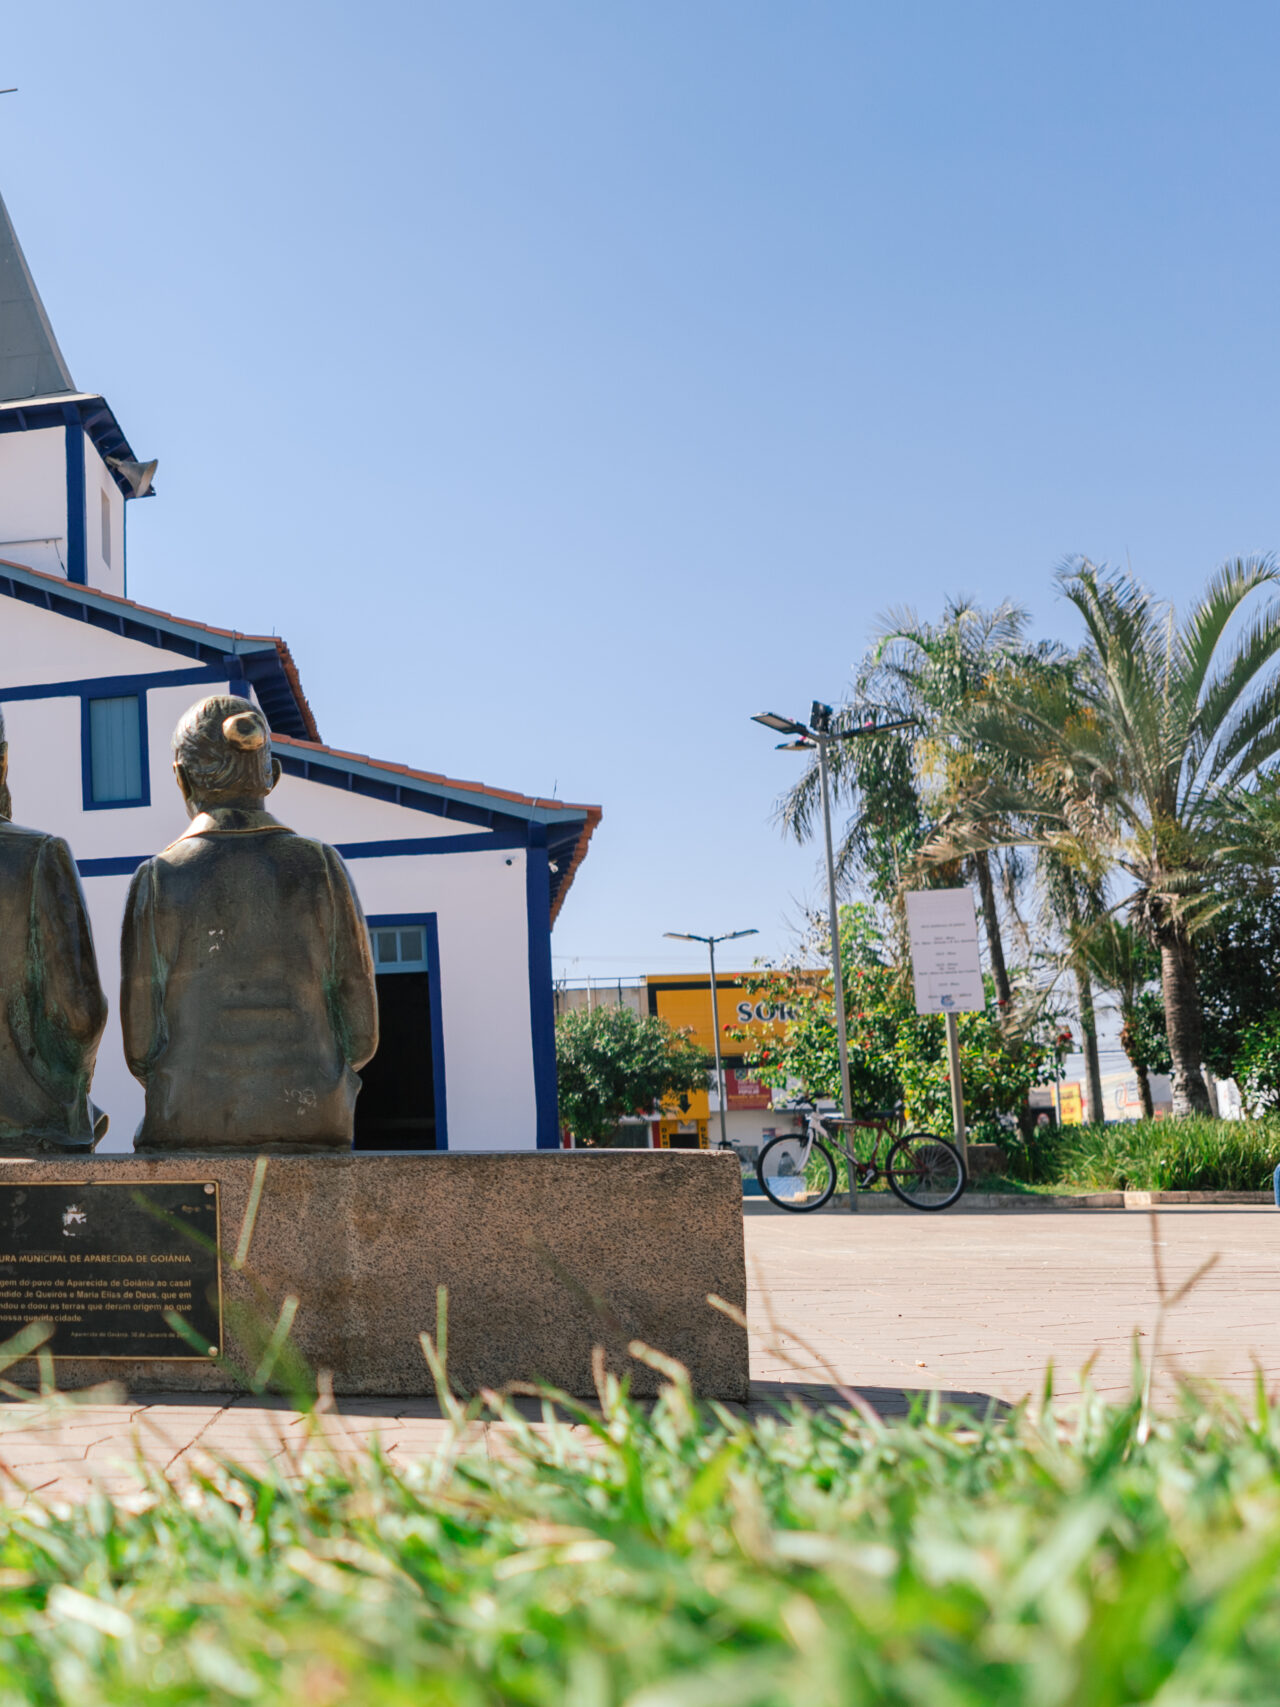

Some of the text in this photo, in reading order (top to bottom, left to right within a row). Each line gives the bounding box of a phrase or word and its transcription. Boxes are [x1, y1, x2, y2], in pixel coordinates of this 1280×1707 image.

[19, 1254, 67, 1263] MUNICIPAL
[70, 1254, 81, 1263] DE
[84, 1254, 133, 1263] APARECIDA
[136, 1254, 148, 1263] DE
[150, 1252, 192, 1263] GOIÂNIA
[19, 1279, 30, 1287] do
[32, 1280, 52, 1288] povo
[54, 1279, 64, 1287] de
[67, 1279, 108, 1288] Aparecida
[111, 1279, 120, 1287] de
[123, 1279, 154, 1287] Goiânia
[170, 1279, 191, 1287] casal
[76, 1291, 99, 1299] Maria
[123, 1291, 133, 1299] de
[161, 1292, 176, 1300] que
[28, 1302, 48, 1310] doou
[62, 1302, 85, 1310] terras
[87, 1303, 103, 1311] que
[105, 1302, 131, 1310] deram
[133, 1302, 161, 1312] origem
[176, 1303, 192, 1312] que
